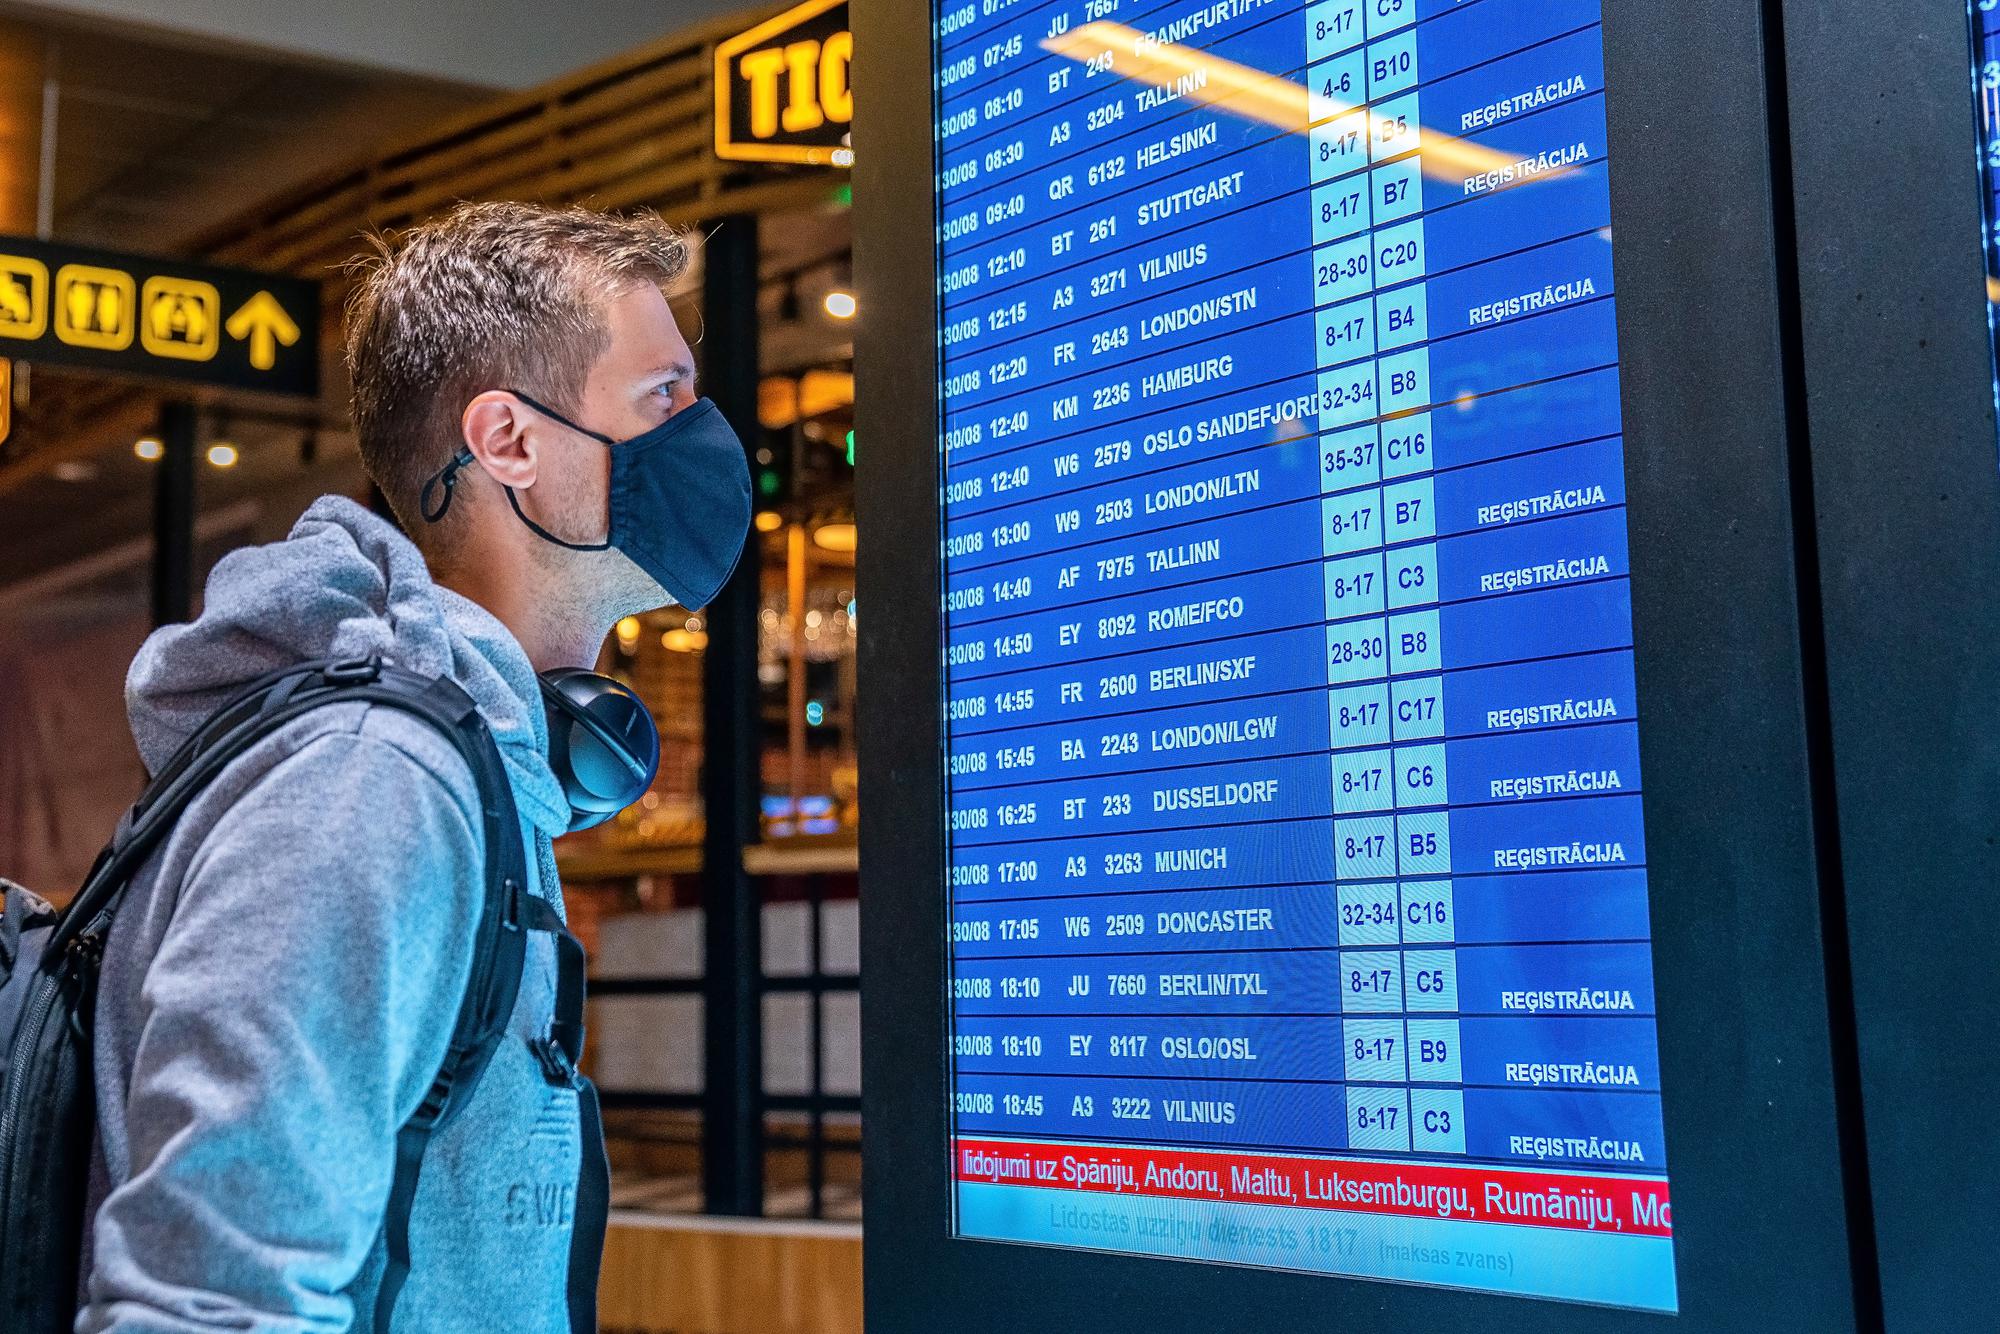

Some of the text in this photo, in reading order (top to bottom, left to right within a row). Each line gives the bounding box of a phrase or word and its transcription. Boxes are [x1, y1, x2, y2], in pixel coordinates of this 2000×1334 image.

[940, 9, 976, 36] 30/08
[941, 12, 1069, 88] 30/08 07:45 JU
[740, 31, 853, 138] TIC
[942, 50, 1114, 139] 30/08 08:10 BT 243
[942, 0, 1402, 191] 30/08 08:30 A3 3204 TALLINN 8-17 C5
[986, 51, 1410, 225] 09:40 QR 6132 HELSINKI 4-6 B10
[943, 75, 1585, 293] 30/08 12:10 BT 261 STUTTGART 8-17 B5 REĢISTRĀCIJA
[988, 142, 1589, 331] 12:15 A3 3271 VILNIUS 8-17 B7 REĢISTRĀCIJA
[945, 240, 1417, 398] 30/08 12:20 FR 2643 LONDON/STN 28-30 C20
[990, 277, 1595, 439] 12:40 KM 2236 HAMBURG 8-17 B4 REĢISTRĀCIJA
[946, 477, 982, 505] 30/08
[990, 465, 1030, 493] 12:40
[1053, 453, 1080, 477] W6
[1094, 440, 1132, 468] 2579
[1143, 424, 1192, 455] OSLO
[1322, 380, 1373, 411] 32-34
[1391, 370, 1416, 396] B8
[991, 432, 1425, 548] 13:00 W9 2503 LONDON/LTN 35-37 C16
[992, 485, 1606, 602] 14:40 AF 7975 TALLINN 8-17 B7 REĢISTRĀCIJA
[948, 555, 1609, 666] 30/08 14:50 EY 8092 ROME/FCO 8-17 C3 REĢISTRĀCIJA
[994, 631, 1427, 714] 14:55 FR 2600 BERLIN/SXF 28-30 B8
[951, 696, 1617, 775] 30/08 15:45 BA 2243 LONDON/LGW 8-17 C17 REĢISTRĀCIJA
[997, 766, 1621, 826] 16:25 BT 233 DUSSELDORF 8-17 C6 REĢISTRĀCIJA
[952, 832, 1625, 886] 30/08 17:00 A3 3263 MUNICH 8-17 B5 REĢISTRĀCIJA
[999, 900, 1446, 940] 17:05 W6 2509 DONCASTER 32-34 C16
[954, 970, 1634, 1014] 30/08 18:10 JU 7660 BERLIN/TXL 8-17 C5 REĢISTRĀCIJA
[1001, 1034, 1639, 1086] 18:10 EY 8117 OSLO/OSL 8-17 B9 REĢISTRĀCIJA
[956, 1093, 1644, 1162] 30/08 18:45 A3 3222 VILNIUS 8-17 C3 REĢISTRĀCIJA
[962, 1150, 1031, 1183] lidojumi
[1034, 1157, 1058, 1181] uz
[1062, 1155, 1140, 1192] Spāniju,
[1144, 1160, 1224, 1199] Andoru,
[1231, 1165, 1298, 1204] Maltu,
[1304, 1170, 1476, 1218] Luksemburgu,
[1484, 1180, 1622, 1231] Rumāniju,
